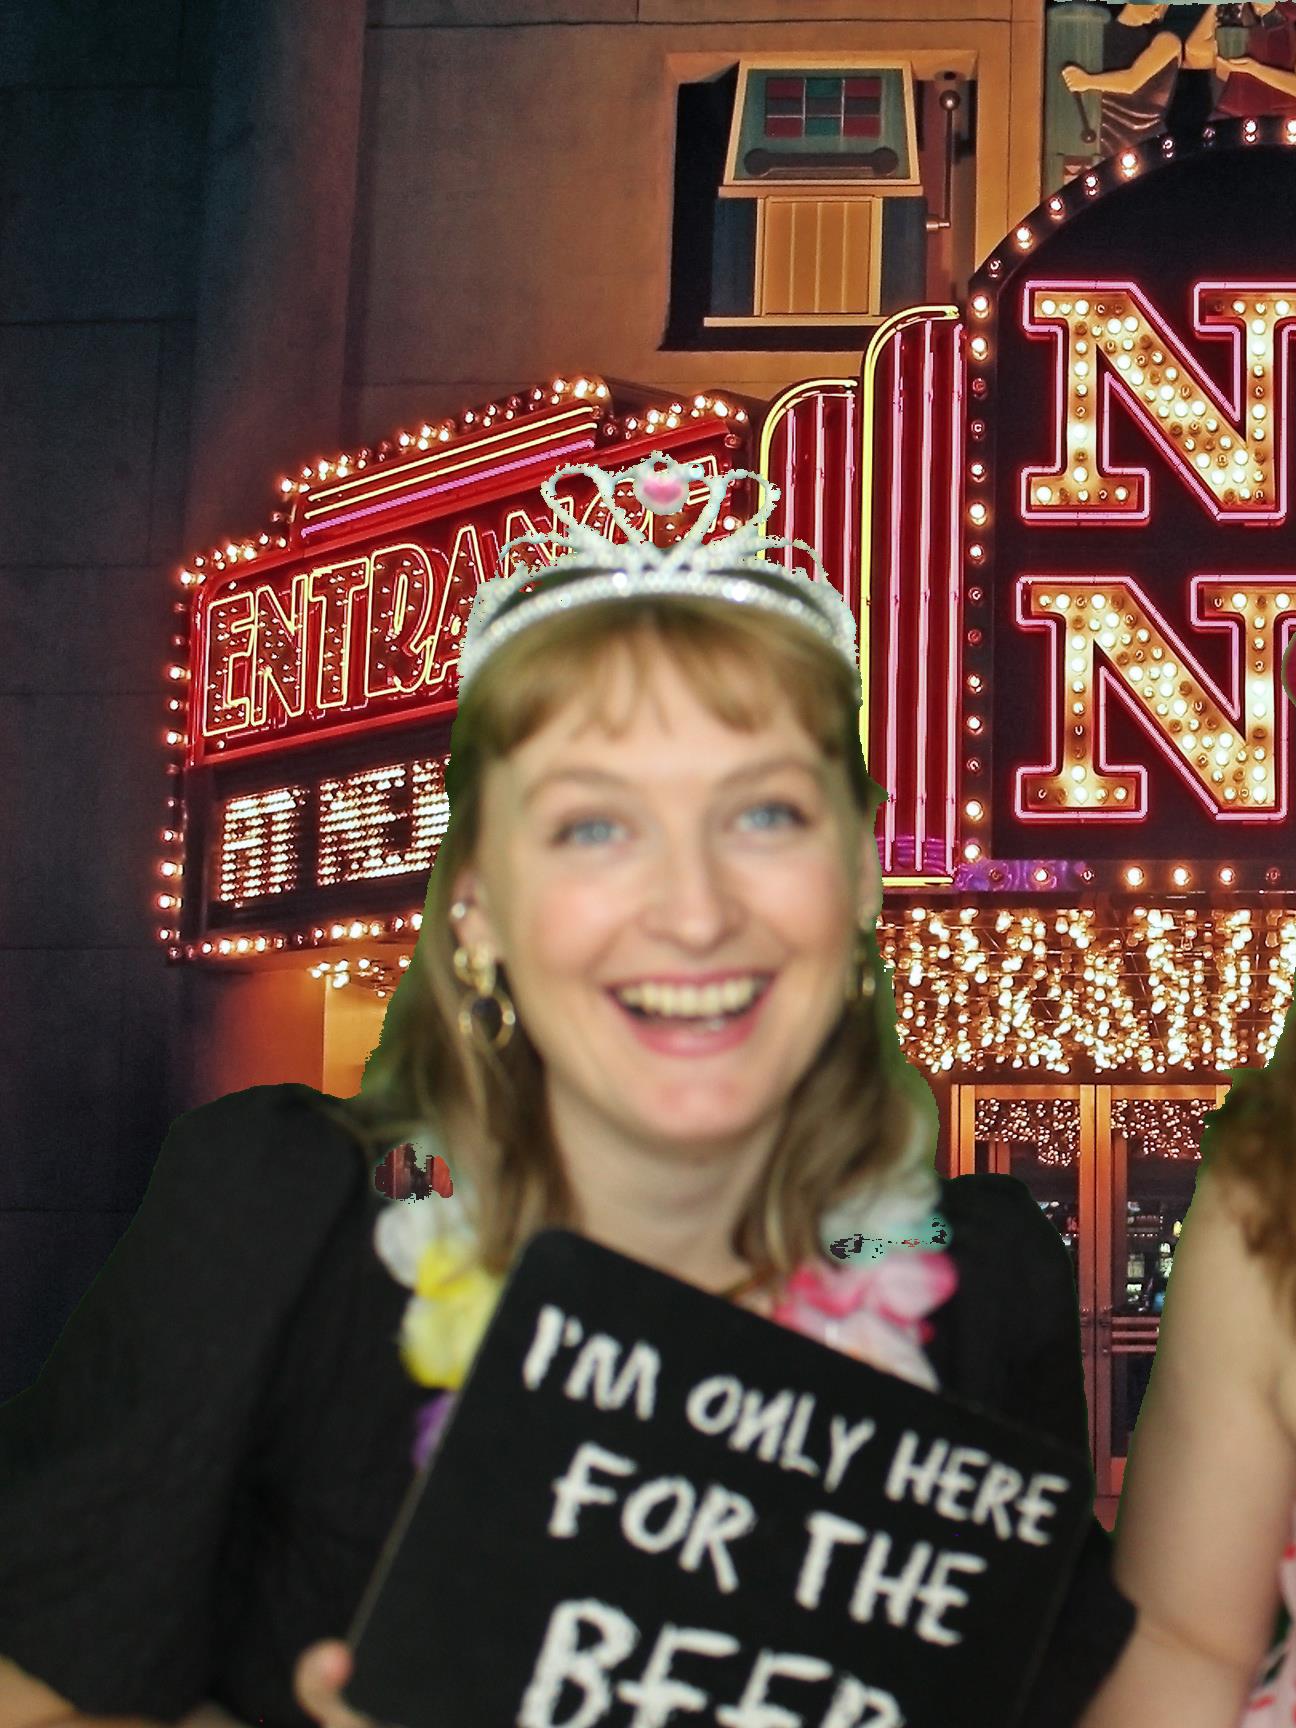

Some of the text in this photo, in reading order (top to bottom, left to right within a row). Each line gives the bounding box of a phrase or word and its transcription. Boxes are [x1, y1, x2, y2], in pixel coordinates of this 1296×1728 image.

[523, 1304, 1070, 1547] I'M ONLY HERE
[549, 1442, 987, 1647] FOR THE
